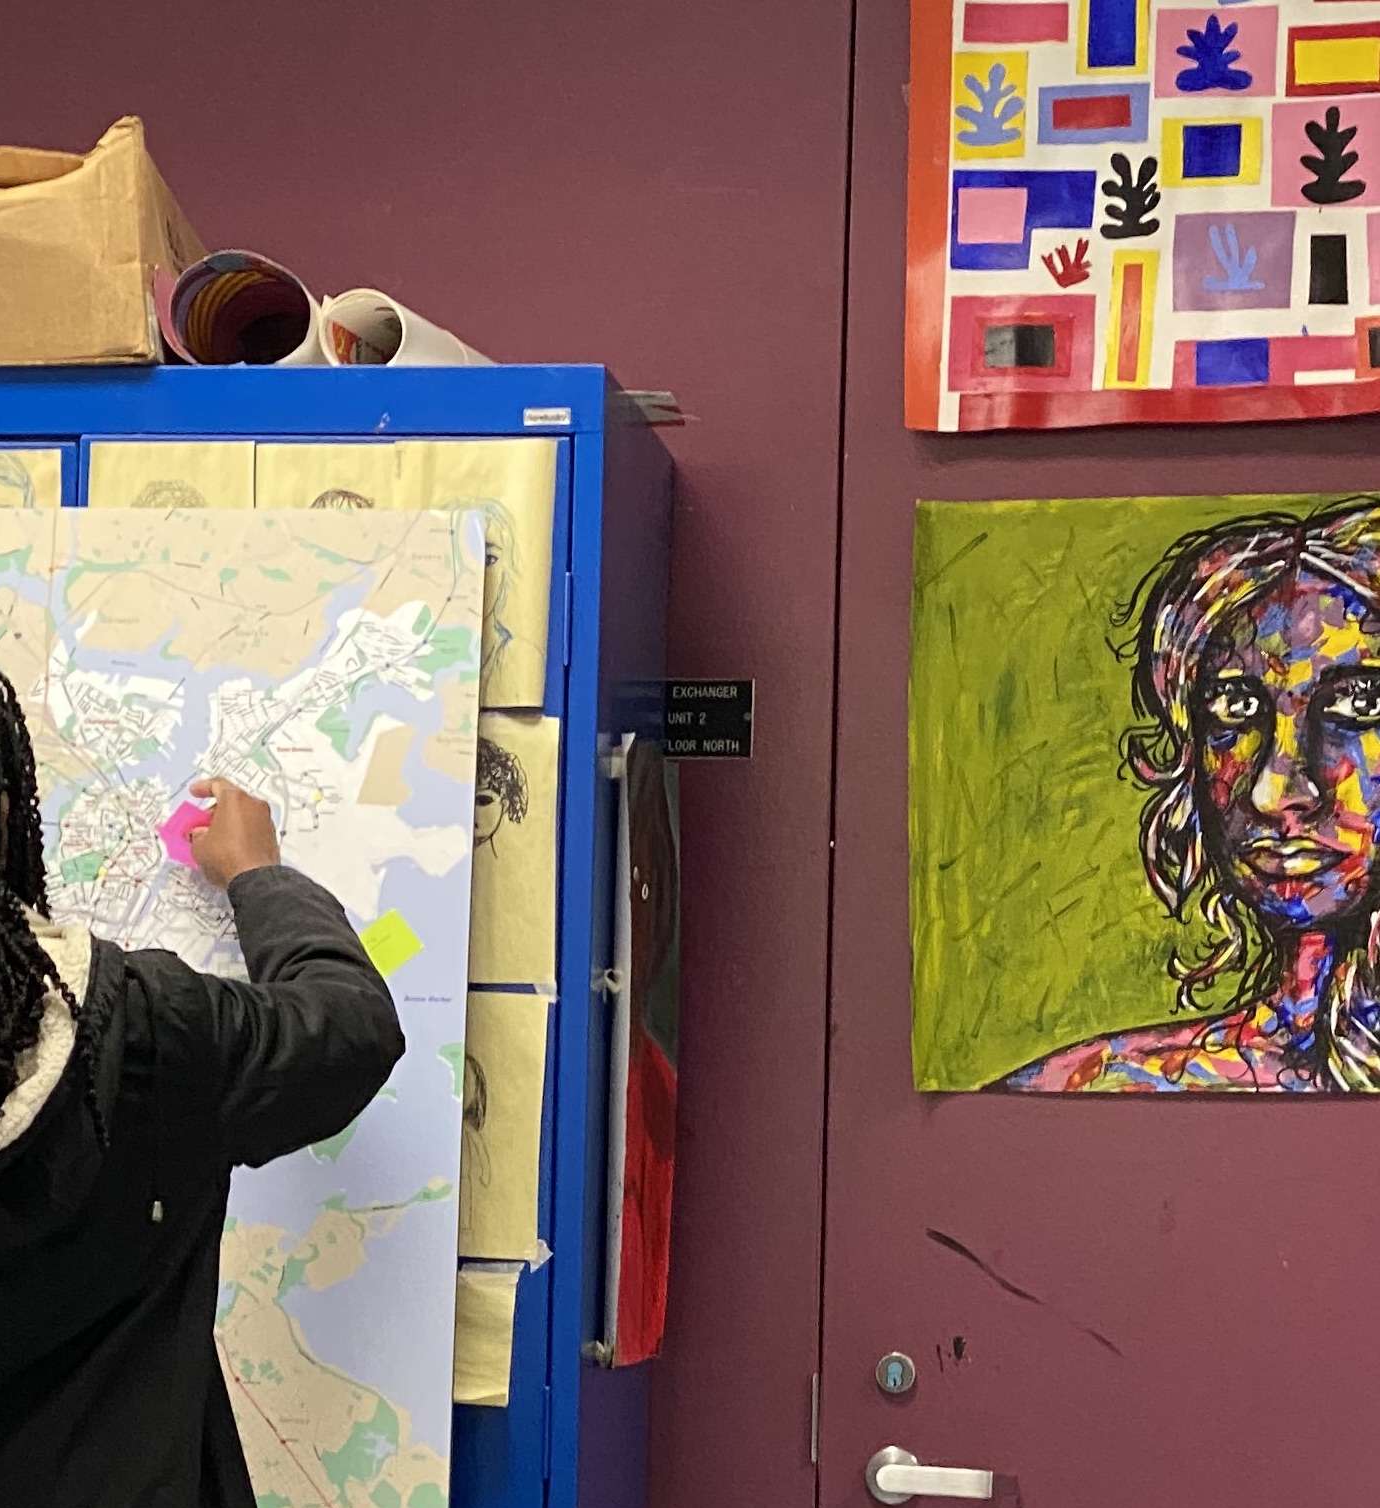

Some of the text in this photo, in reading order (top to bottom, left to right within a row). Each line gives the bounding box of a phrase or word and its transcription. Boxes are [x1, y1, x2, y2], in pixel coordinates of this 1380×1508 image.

[672, 685, 738, 699] EXCHANGER
[667, 711, 707, 725] UNIT 2
[702, 739, 740, 753] NORTH
